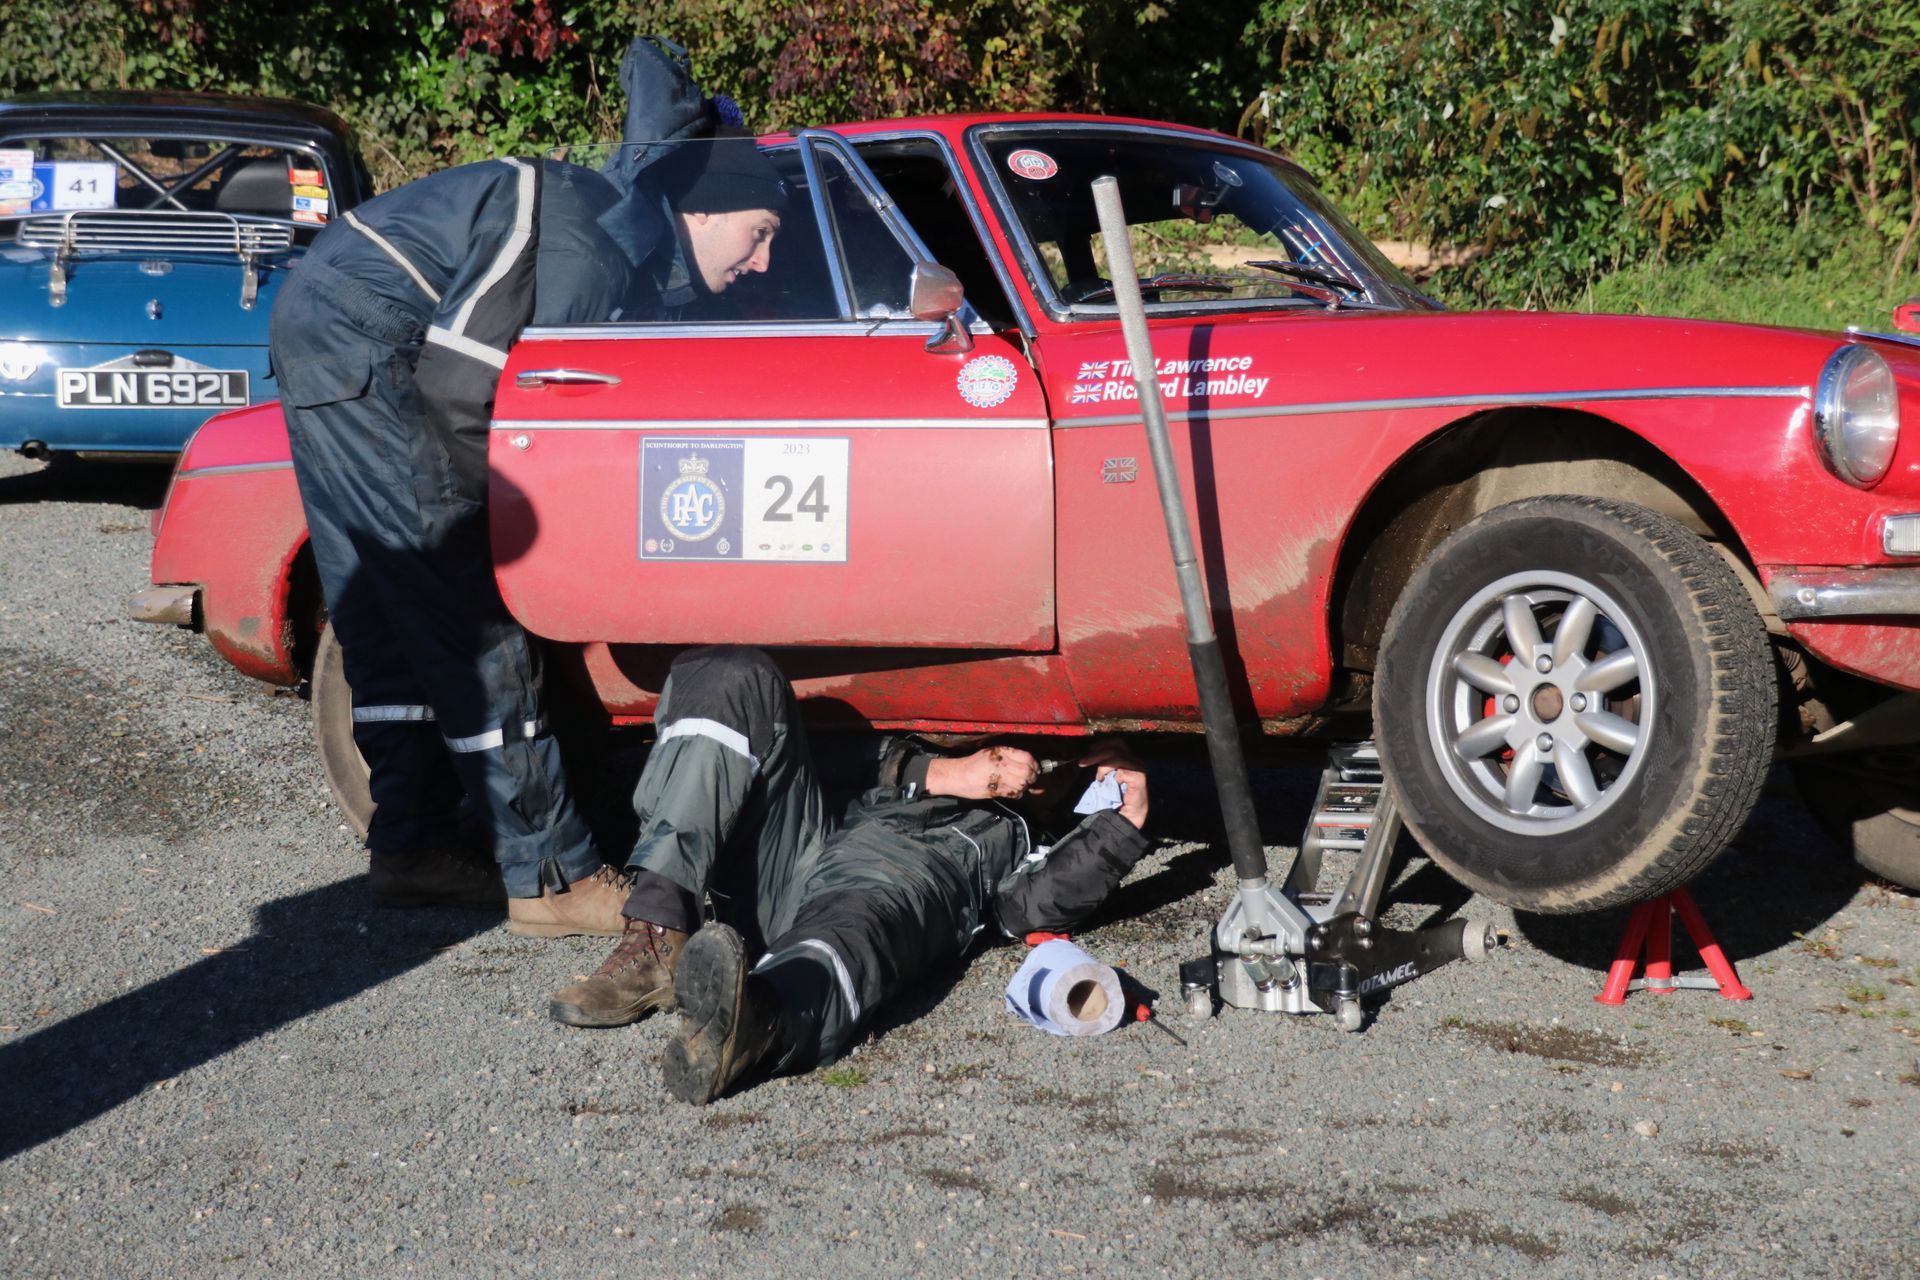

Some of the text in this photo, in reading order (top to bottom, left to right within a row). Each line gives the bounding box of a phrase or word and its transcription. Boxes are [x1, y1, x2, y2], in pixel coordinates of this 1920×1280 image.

[69, 179, 98, 193] 41
[1154, 356, 1252, 375] Lawrence
[63, 373, 246, 404] PLN 692L
[1103, 374, 1269, 401] Ricrd Lambley
[782, 443, 811, 455] 2023
[672, 483, 713, 527] RAC
[762, 475, 830, 523] 24
[1358, 961, 1414, 994] OTAMEC
